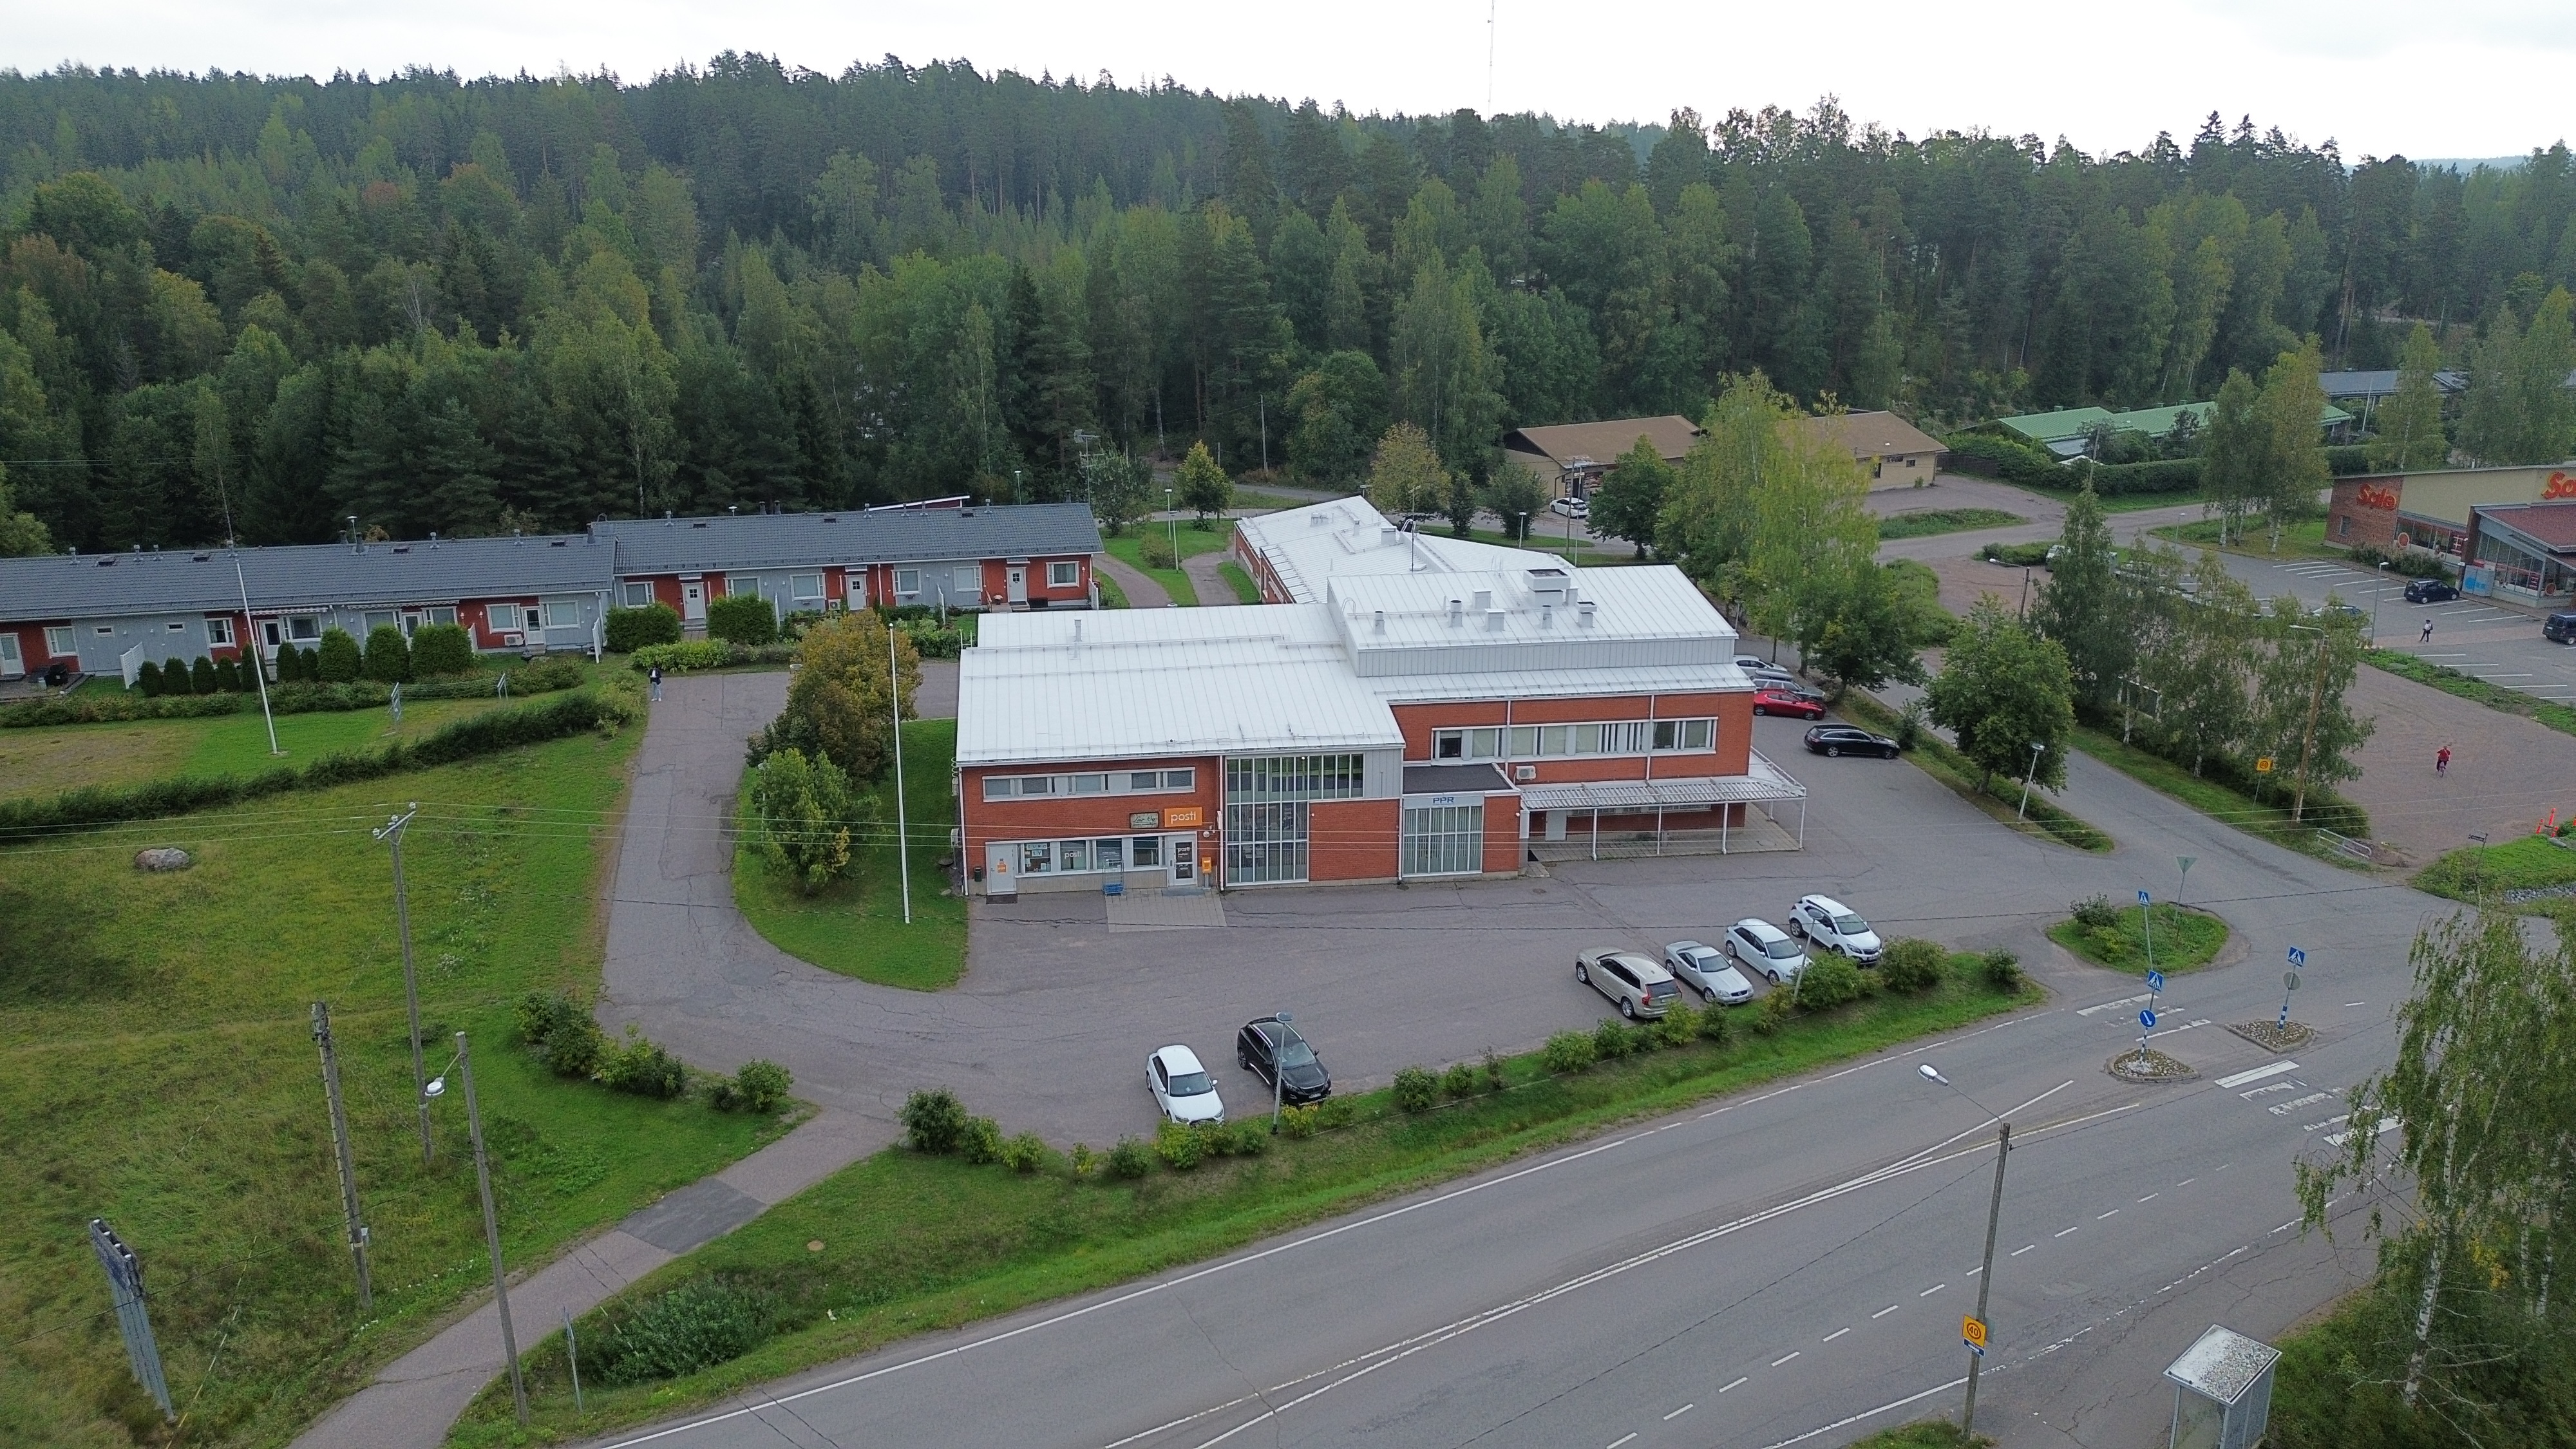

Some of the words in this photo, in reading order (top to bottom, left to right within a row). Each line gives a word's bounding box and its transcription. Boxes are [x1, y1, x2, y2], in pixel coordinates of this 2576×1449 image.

[2357, 484, 2396, 511] Sale
[1171, 811, 1197, 824] posti
[1064, 850, 1082, 860] posti
[1969, 1325, 1978, 1336] 40
